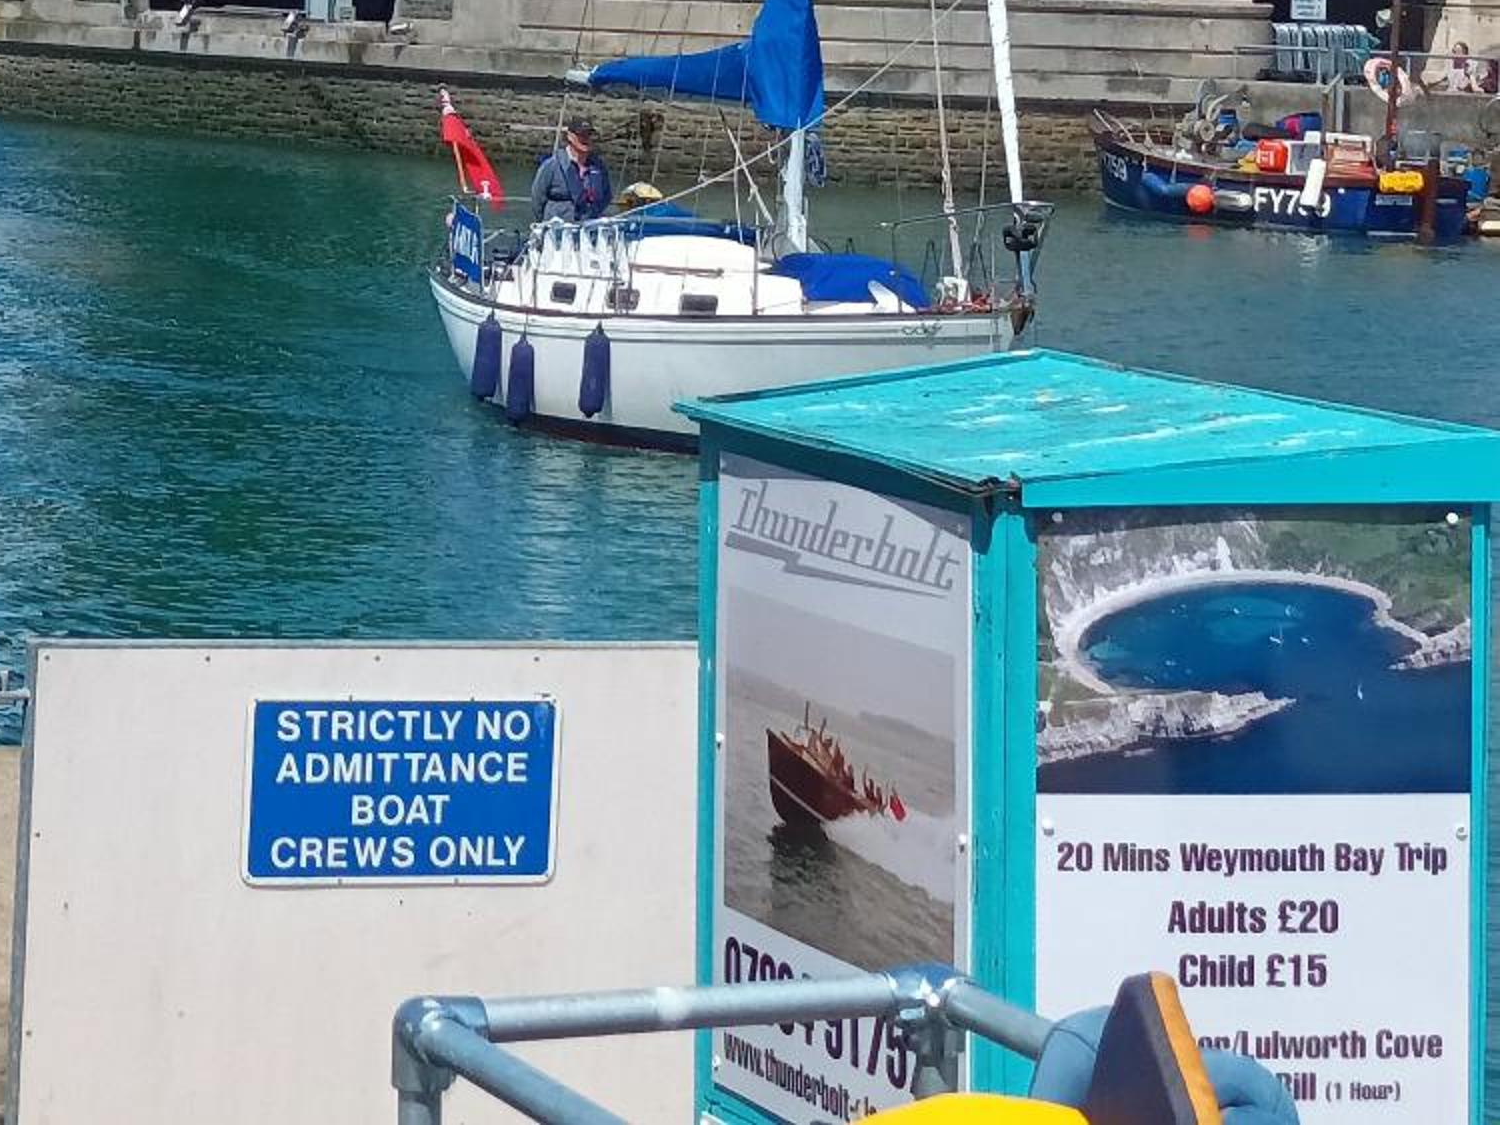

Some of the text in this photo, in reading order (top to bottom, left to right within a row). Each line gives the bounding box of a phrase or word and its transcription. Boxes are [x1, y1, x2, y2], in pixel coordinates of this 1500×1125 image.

[729, 480, 961, 591] Thunderbolt
[276, 709, 531, 742] STRICTLY NO
[275, 752, 529, 784] ADMITTANCE
[350, 794, 451, 826] BOAT
[270, 835, 526, 869] CREWS ONLY
[1057, 842, 1448, 877] 20 Mins Weymouth Bay Trip
[1167, 900, 1340, 934] Adults £20
[1178, 954, 1327, 987] Child £15
[1375, 1029, 1444, 1059] Cove
[1350, 1081, 1401, 1102] Hour)
